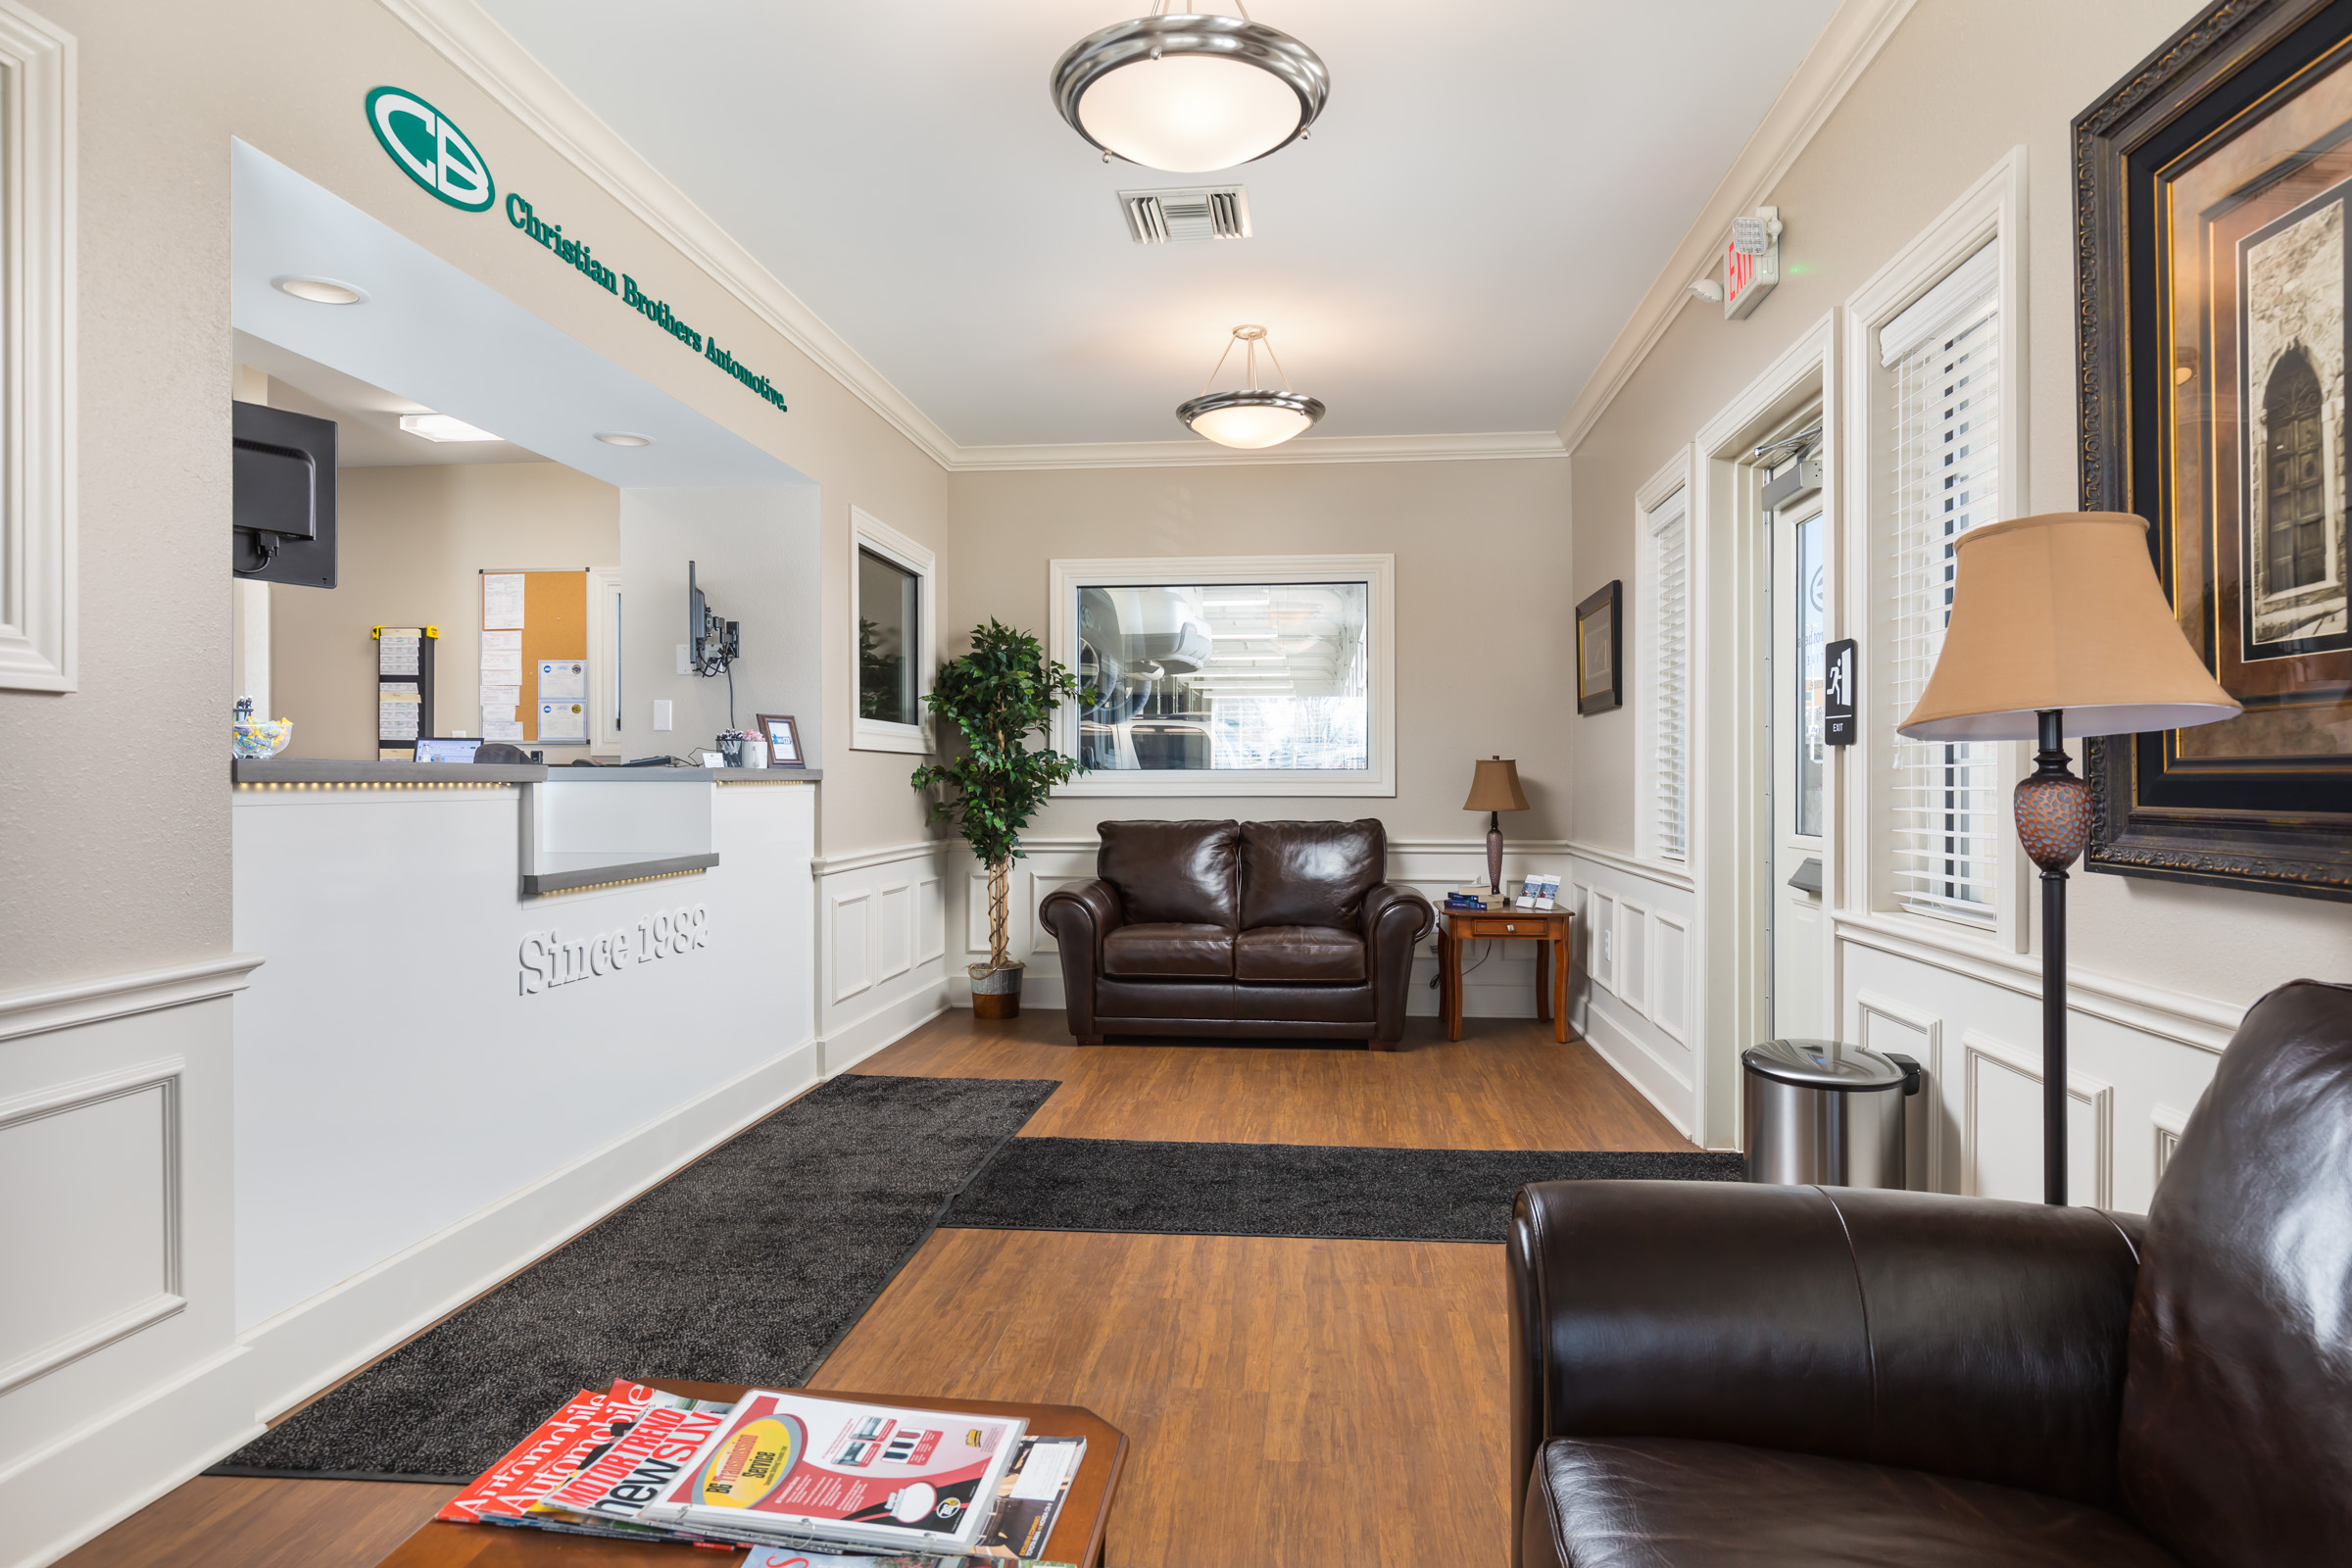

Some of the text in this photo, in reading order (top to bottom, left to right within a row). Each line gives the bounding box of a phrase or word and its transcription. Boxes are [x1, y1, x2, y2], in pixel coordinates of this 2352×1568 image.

[506, 192, 618, 295] Christian
[621, 273, 703, 354] Brothers
[1833, 722, 1843, 732] EXIT
[518, 904, 709, 997] Since 1982
[550, 1453, 638, 1508] MOTOR
[612, 1407, 687, 1458] TREND
[706, 1434, 760, 1494] BG Transmission
[742, 1450, 776, 1479] Service
